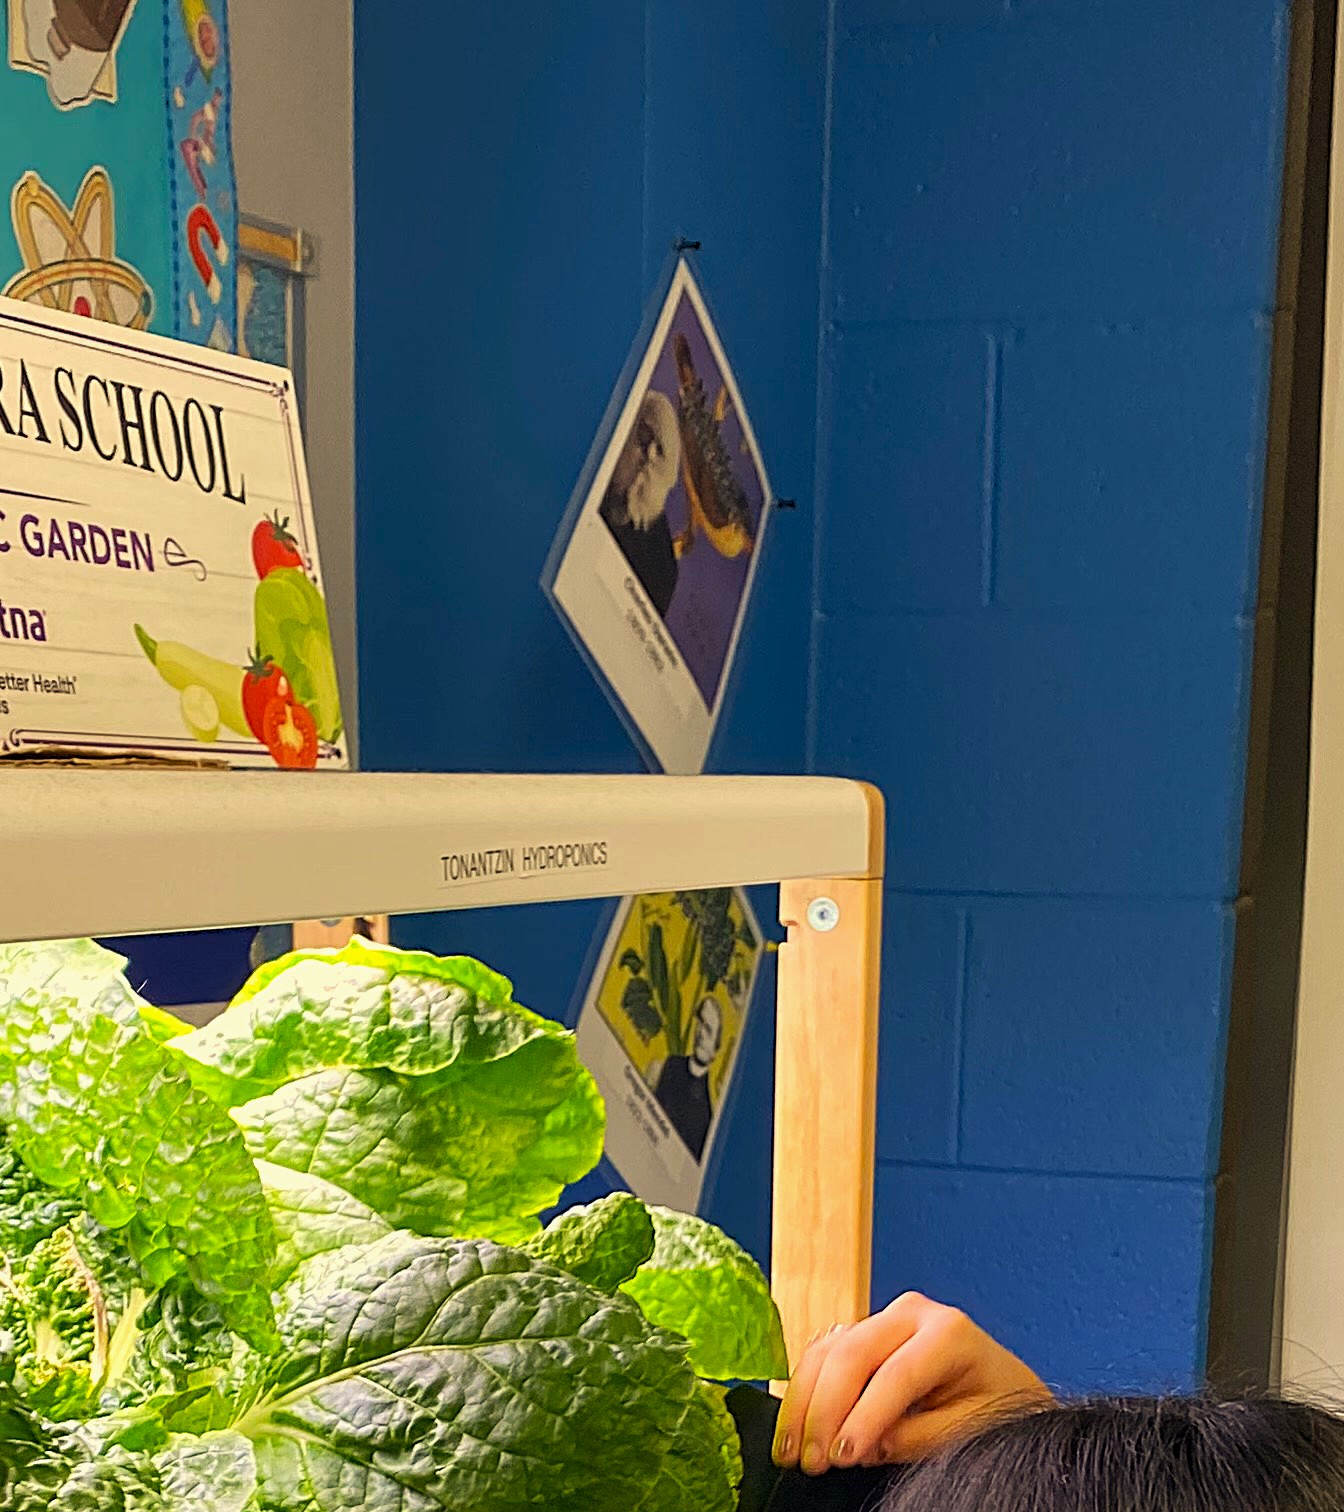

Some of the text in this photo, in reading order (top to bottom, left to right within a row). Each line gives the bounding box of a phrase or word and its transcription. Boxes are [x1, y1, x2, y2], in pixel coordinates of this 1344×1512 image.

[54, 366, 246, 505] SCHOOL
[20, 513, 155, 572] GARDEN
[440, 841, 608, 881] TONANTZIN HYDROPONICS
